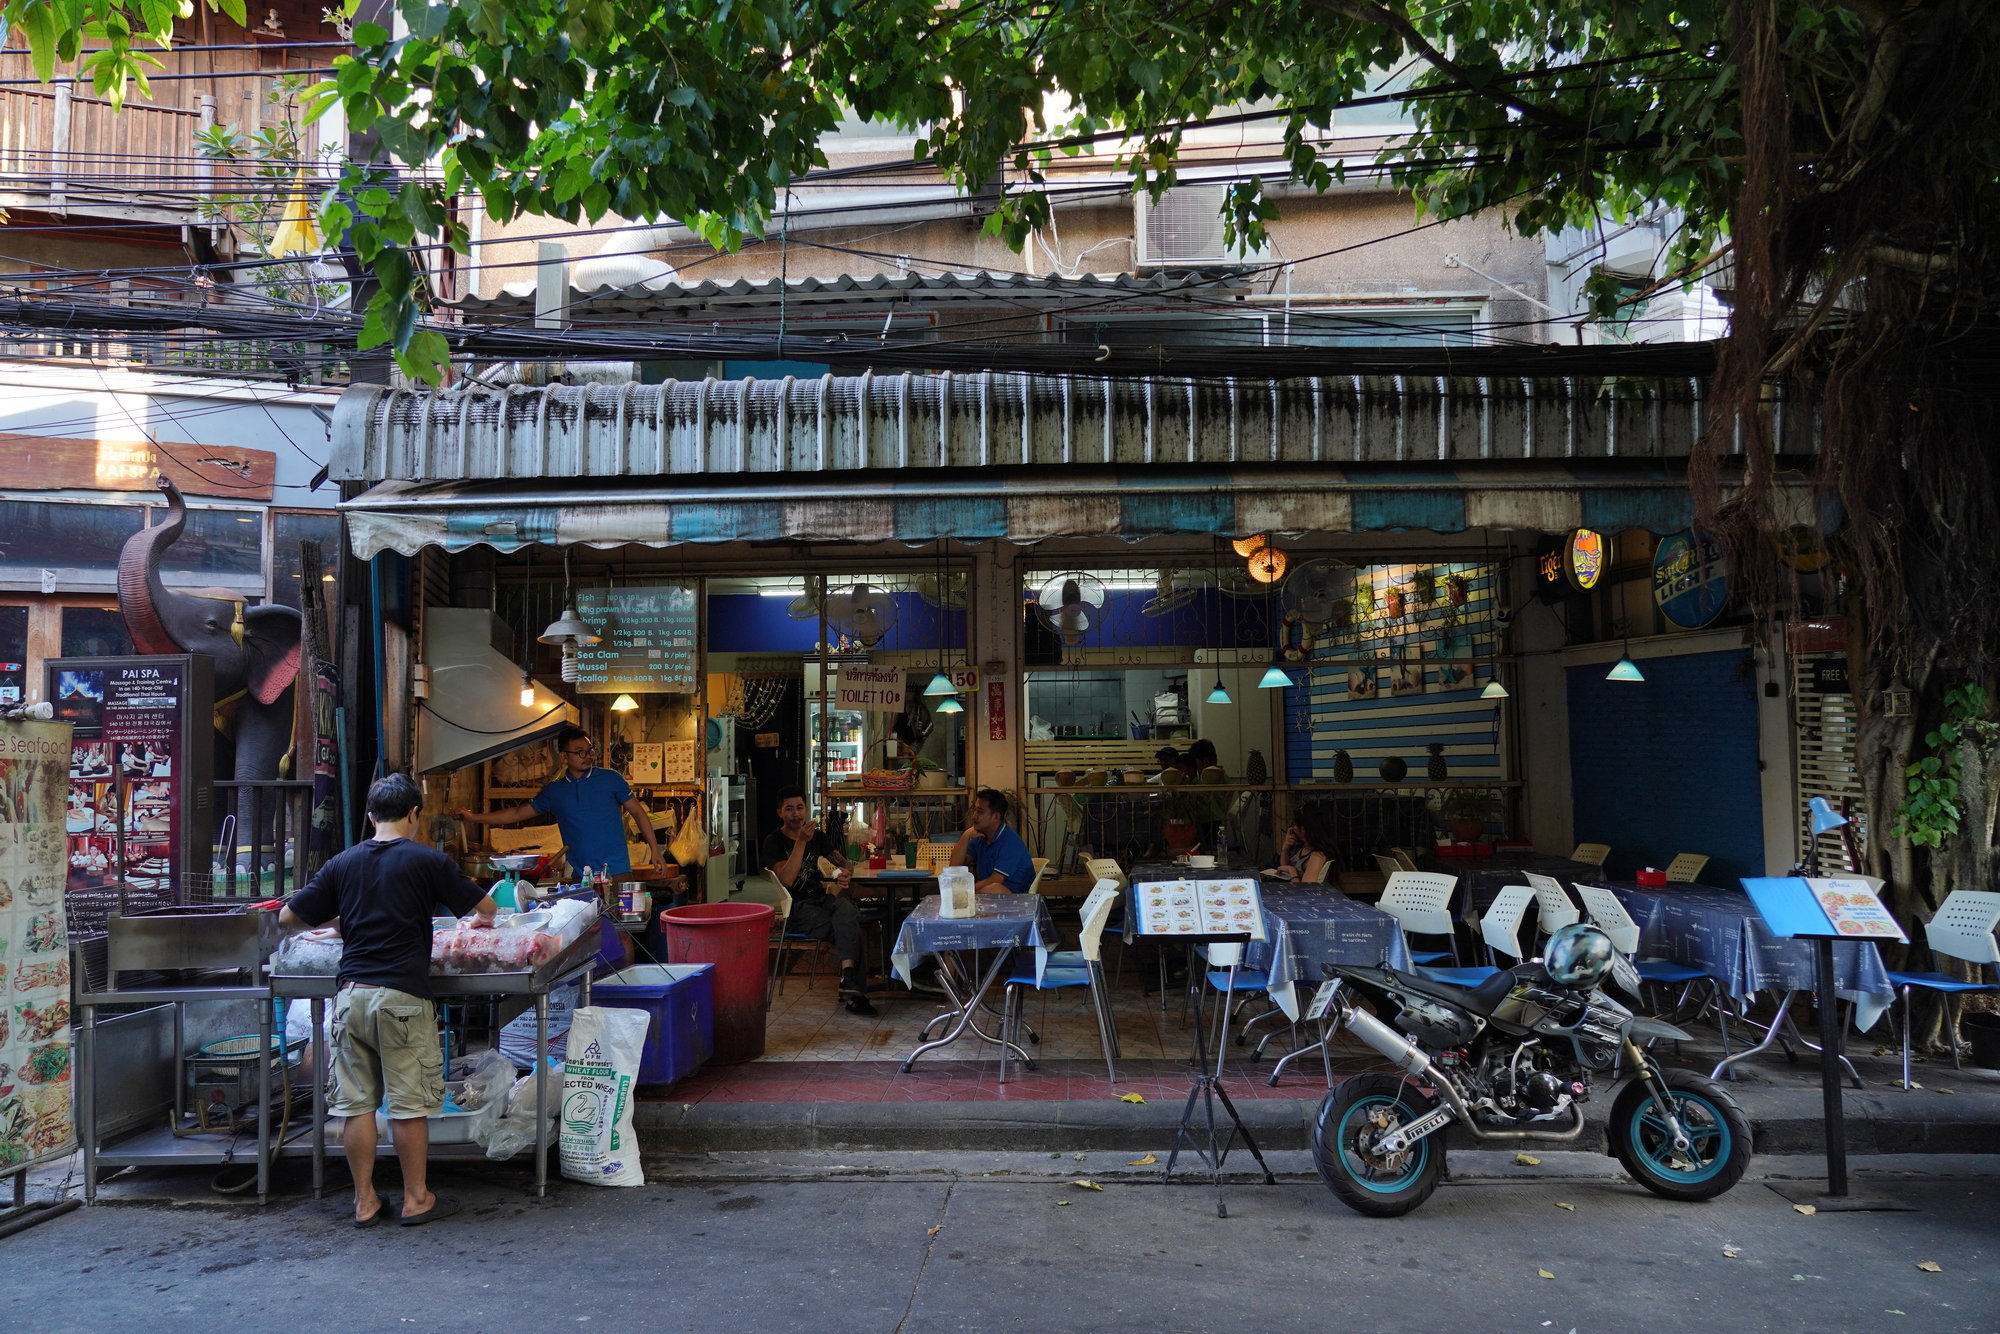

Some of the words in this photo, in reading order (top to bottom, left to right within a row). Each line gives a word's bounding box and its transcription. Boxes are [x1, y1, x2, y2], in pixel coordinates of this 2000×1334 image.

[129, 465, 160, 478] SPA
[1540, 551, 1562, 582] Tiger
[1661, 565, 1715, 600] LIGHT
[582, 617, 607, 626] hrimp
[577, 651, 594, 659] Sea
[597, 651, 619, 659] Clam
[577, 662, 608, 671] Mussel
[122, 669, 139, 679] PAI
[141, 669, 160, 678] SPA
[577, 673, 609, 683] Scallop
[840, 689, 877, 704] TOILET
[11, 735, 68, 755] Seafood
[566, 1065, 591, 1075] WHEAT
[592, 1068, 610, 1076] FLOUR
[595, 1082, 615, 1096] WHEAT
[1404, 1111, 1445, 1140] PIRELLI
